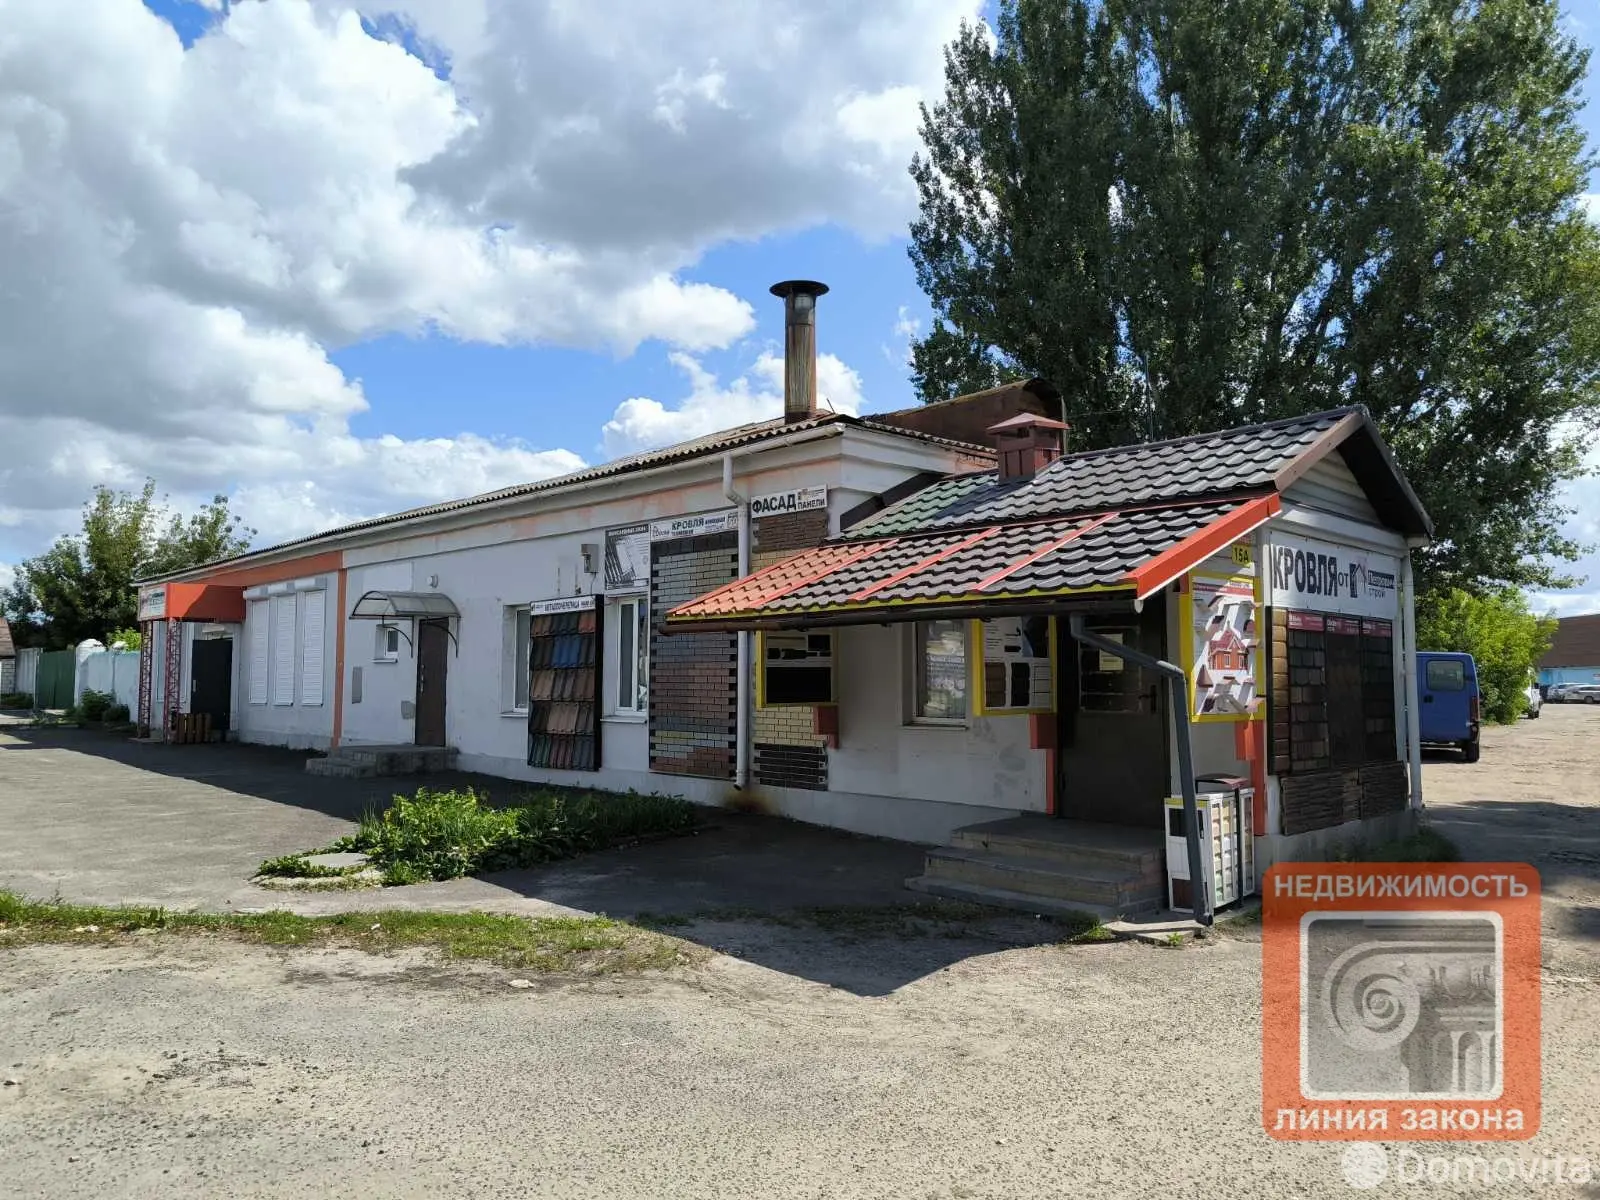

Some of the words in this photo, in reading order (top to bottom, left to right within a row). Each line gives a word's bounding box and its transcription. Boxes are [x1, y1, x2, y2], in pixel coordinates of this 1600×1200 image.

[752, 494, 797, 514] ФАСАД
[797, 498, 826, 511] ПАНЕЛИ
[671, 517, 705, 531] КРОВЛЯ
[1273, 545, 1338, 597] КРОВЛЯ
